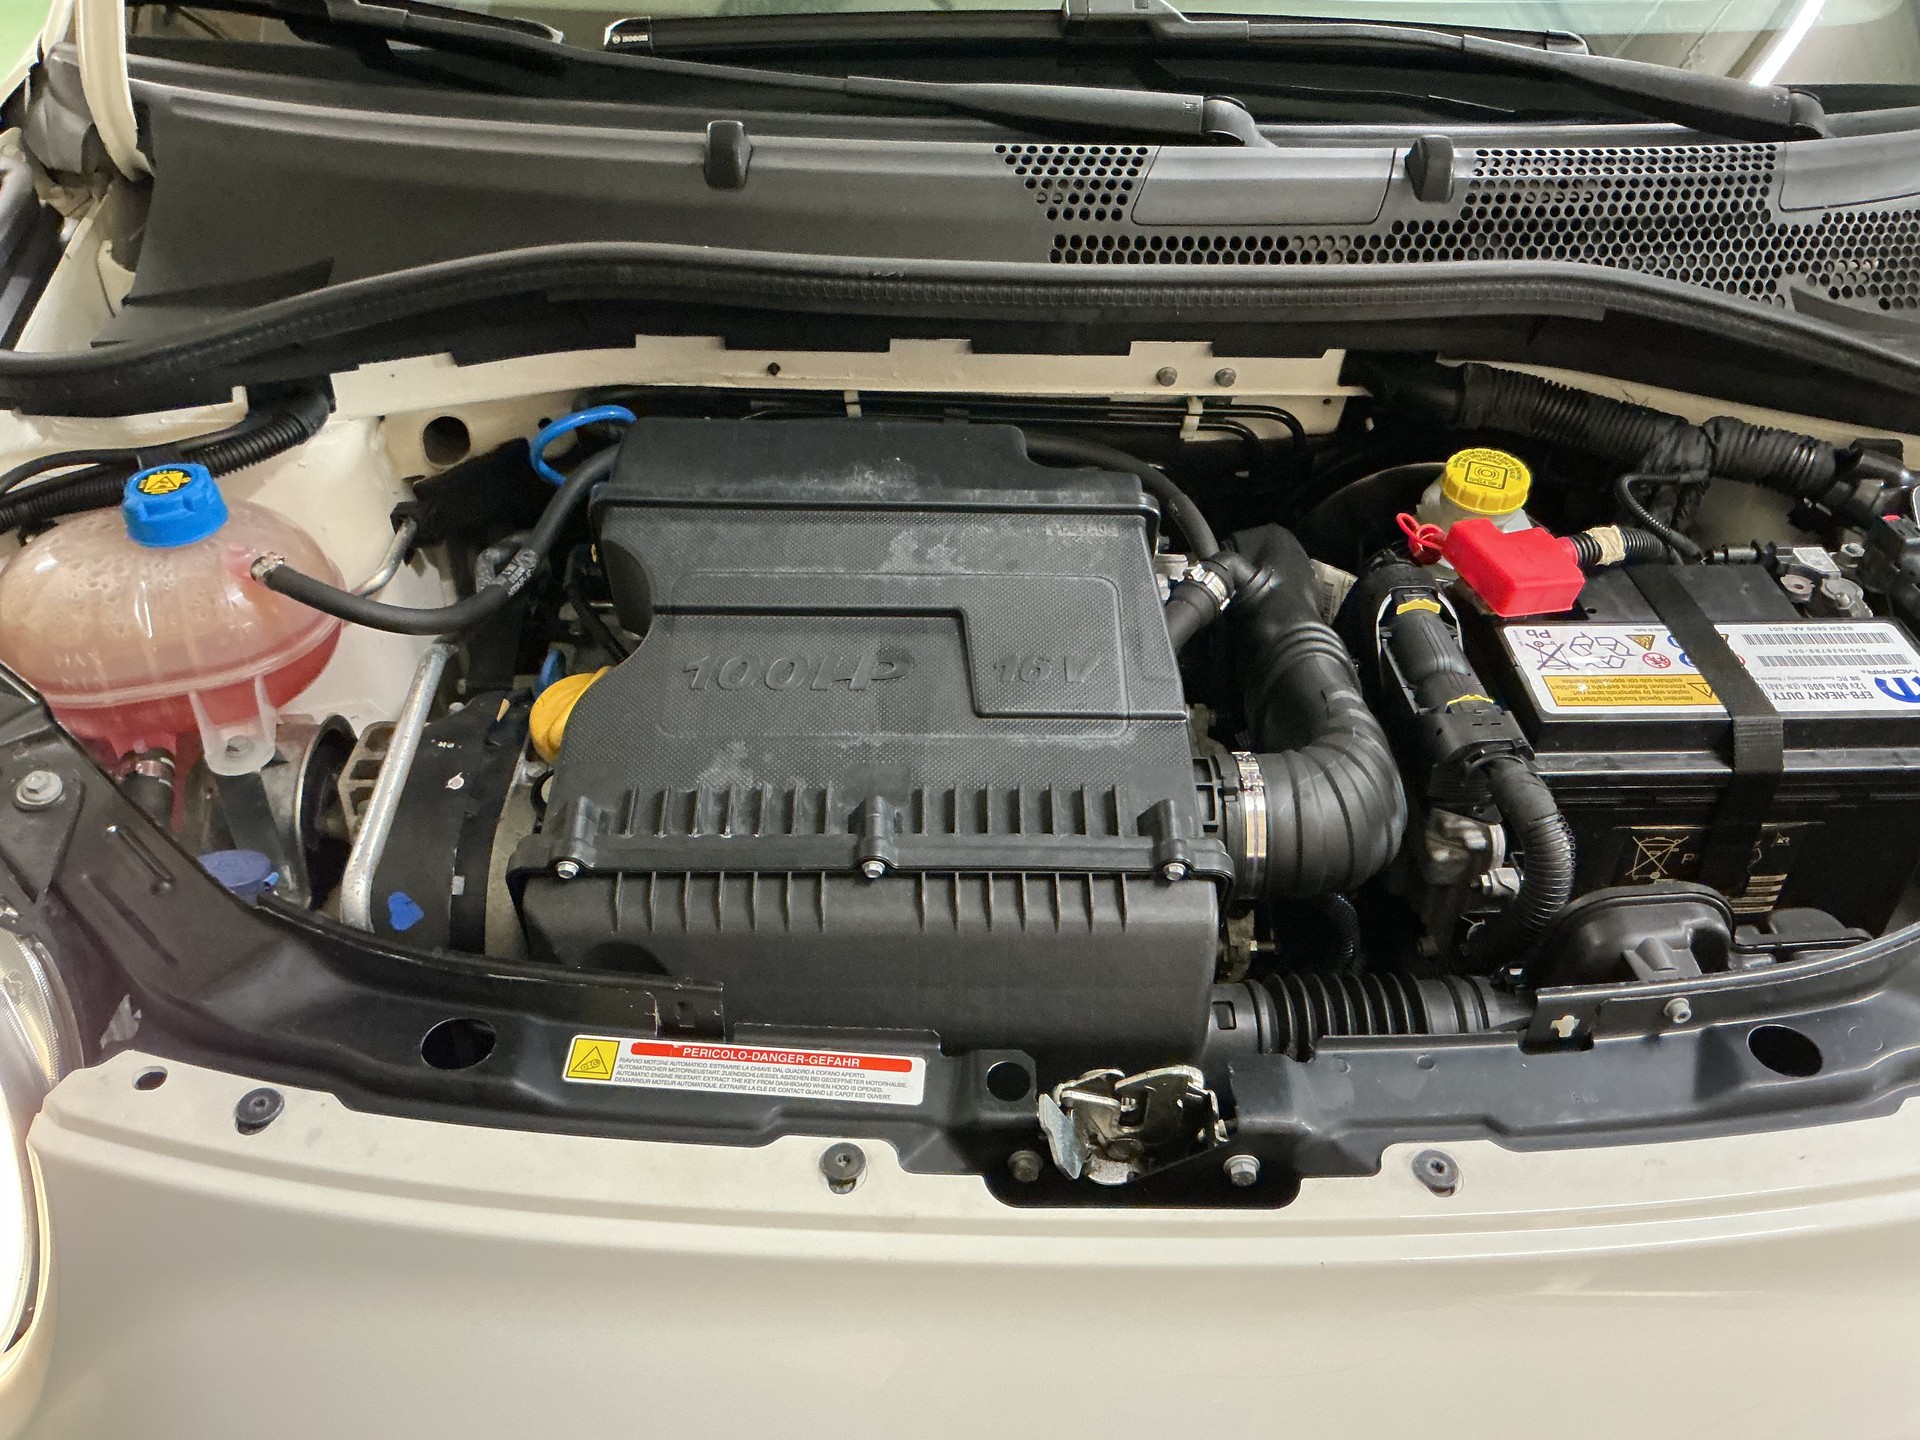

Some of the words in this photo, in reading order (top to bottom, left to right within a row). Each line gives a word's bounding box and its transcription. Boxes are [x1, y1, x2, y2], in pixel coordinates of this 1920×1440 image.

[1526, 629, 1552, 639] Pb
[994, 654, 1099, 684] 16V
[1772, 691, 1805, 700] DUTY
[1807, 691, 1874, 700] EFB-HEAVY
[682, 1047, 861, 1068] PERICOLO-DANGER-GEFAHR
[750, 1065, 772, 1073] CHIAVE
[616, 1070, 650, 1078] AUTOMATIC
[702, 1075, 731, 1083] EXTRACT
[775, 1080, 812, 1088] DASHBOARD
